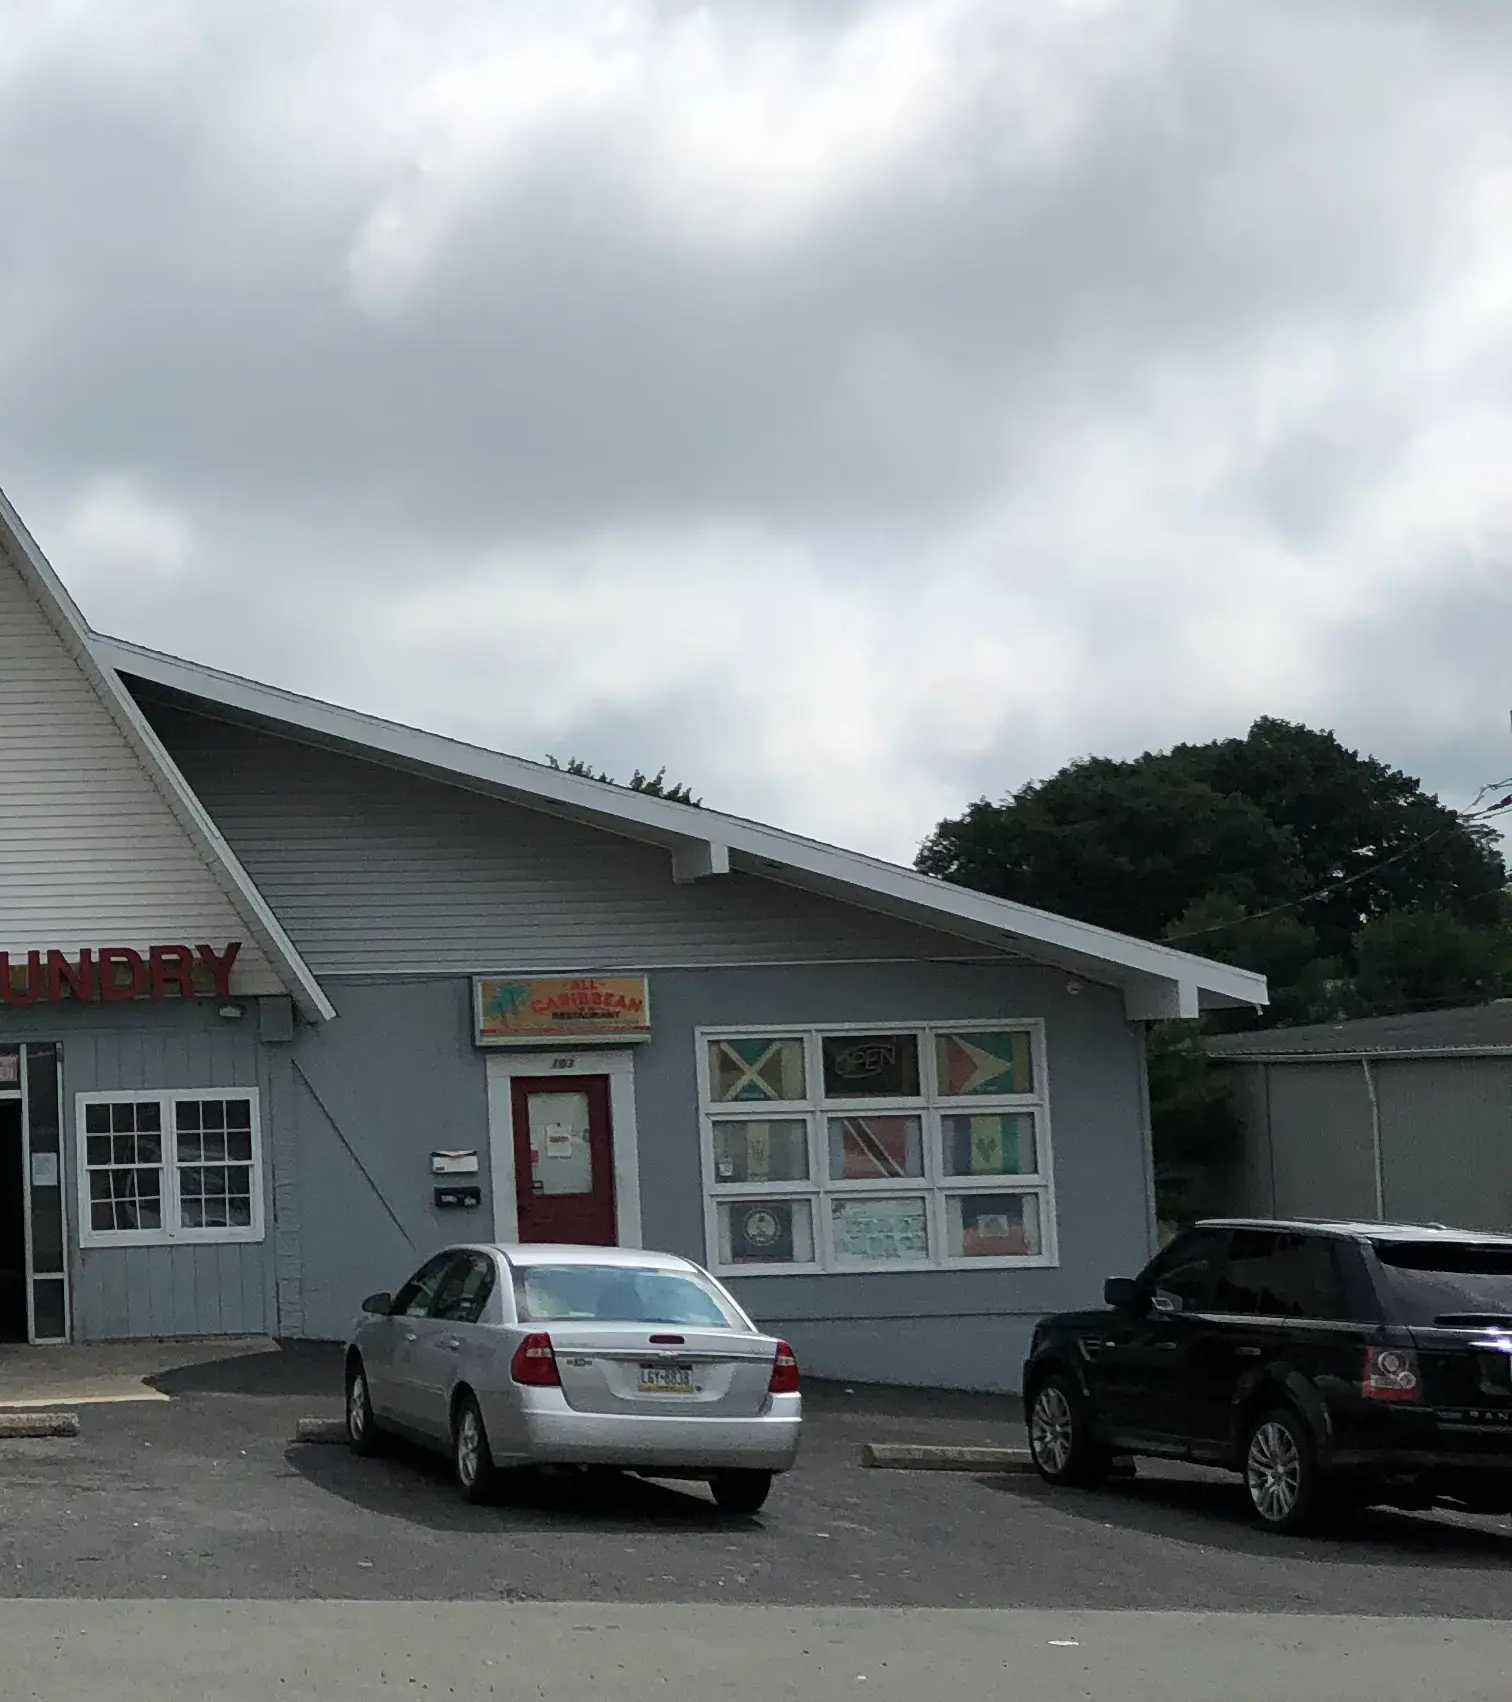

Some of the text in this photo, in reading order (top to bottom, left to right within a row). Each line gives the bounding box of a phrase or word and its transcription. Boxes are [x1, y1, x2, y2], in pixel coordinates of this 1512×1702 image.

[570, 979, 598, 990] ALL
[530, 991, 643, 1013] CARIBBEAN
[551, 1010, 621, 1020] RESTAURANT
[552, 1058, 575, 1070] 103
[836, 1044, 896, 1075] OPEN
